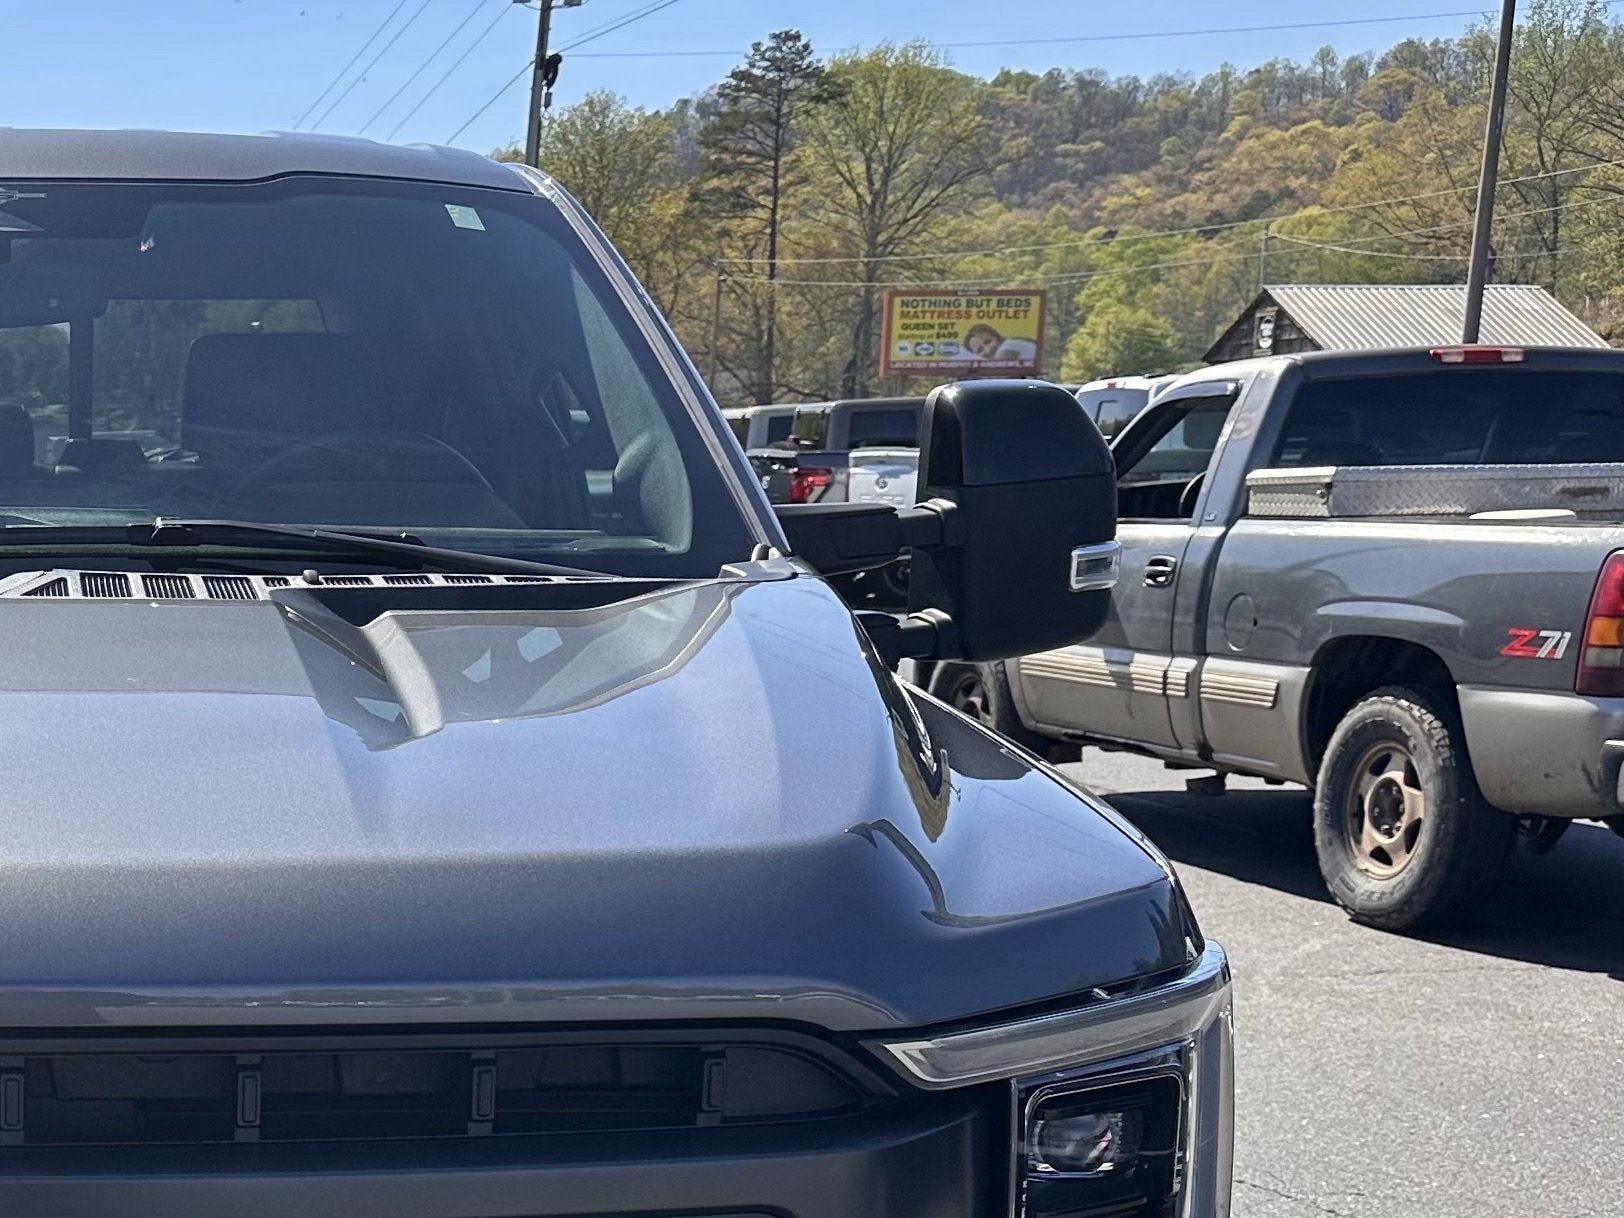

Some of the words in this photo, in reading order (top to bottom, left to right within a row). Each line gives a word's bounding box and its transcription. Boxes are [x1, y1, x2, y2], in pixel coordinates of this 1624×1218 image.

[900, 298, 962, 309] NOTHING
[965, 298, 993, 309] BUT
[996, 298, 1032, 308] BEDS
[899, 309, 972, 320] MATTRESS
[976, 309, 1031, 319] OUTLET
[901, 322, 935, 331] QUEEN
[937, 322, 956, 330] SET
[1500, 627, 1572, 659] Z71
